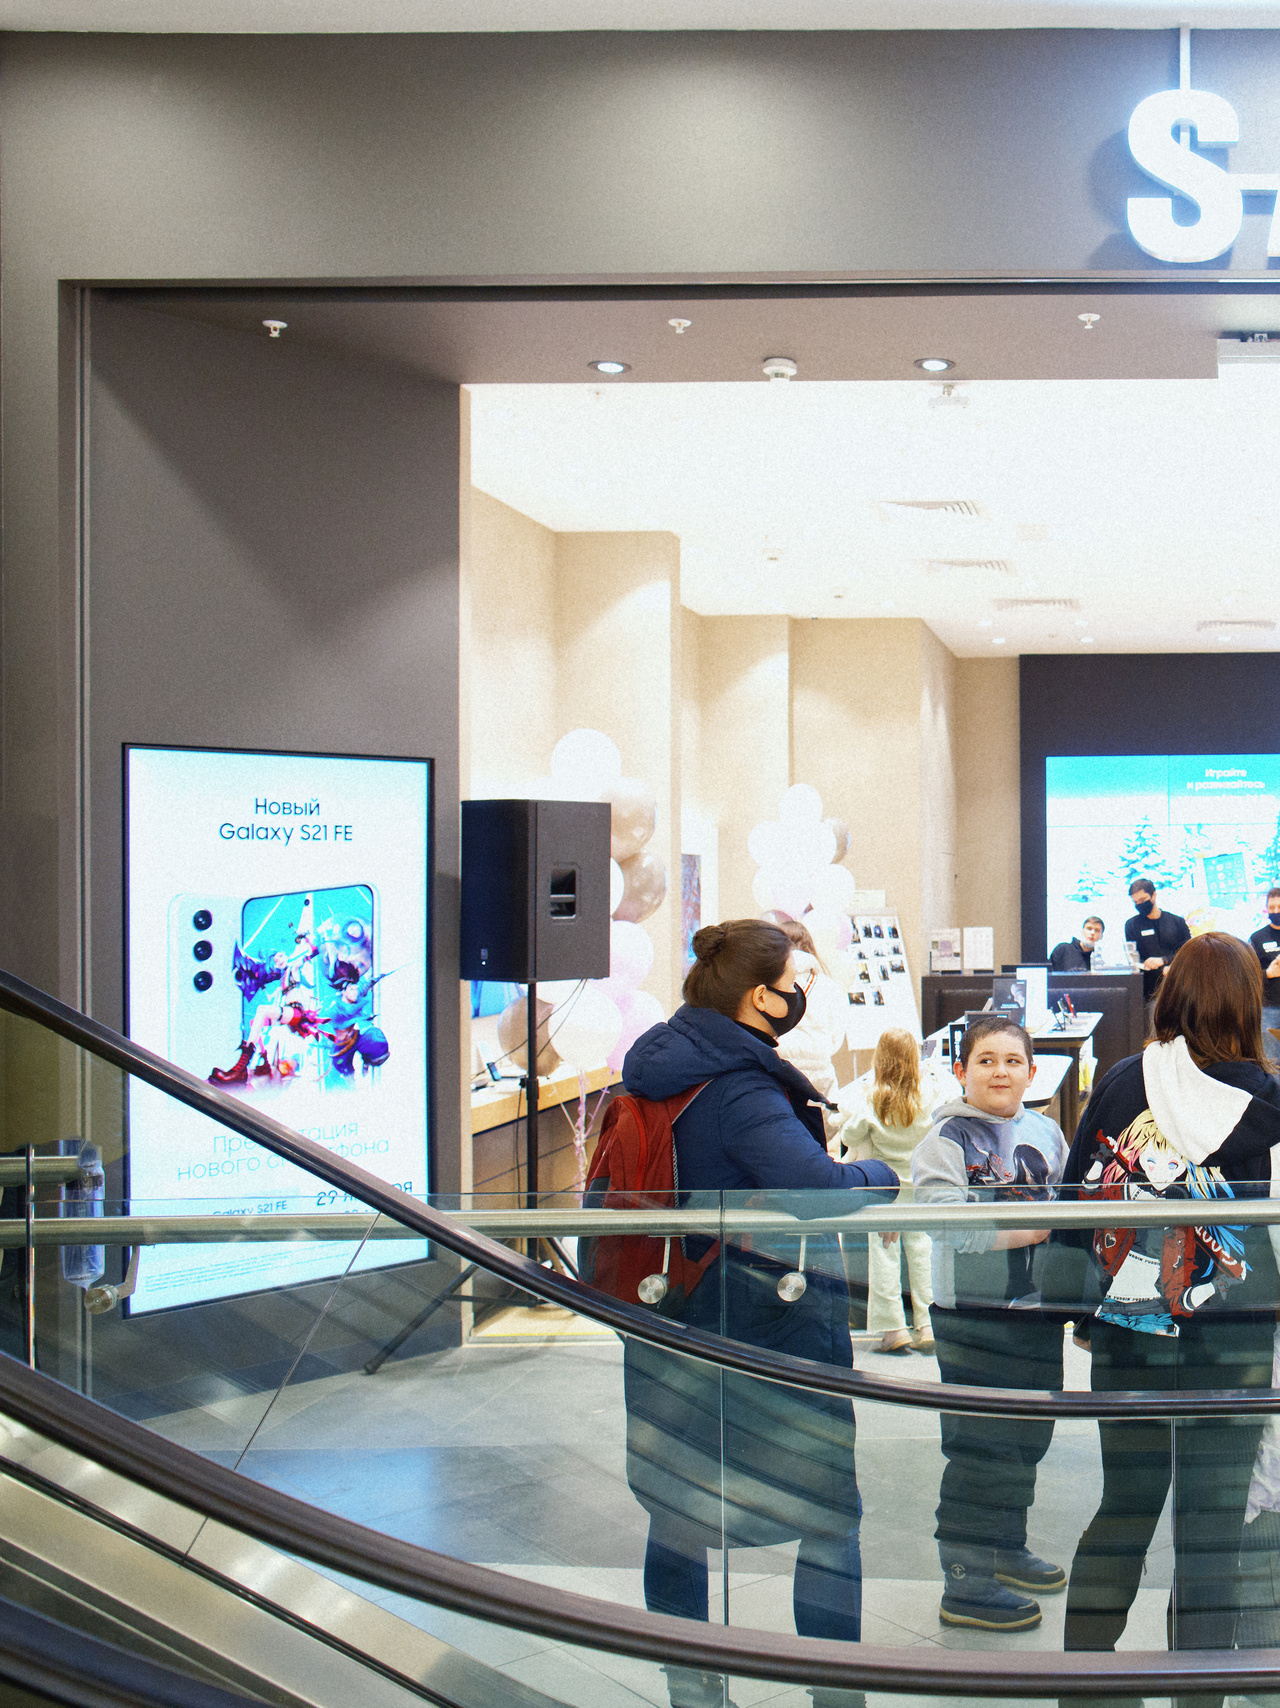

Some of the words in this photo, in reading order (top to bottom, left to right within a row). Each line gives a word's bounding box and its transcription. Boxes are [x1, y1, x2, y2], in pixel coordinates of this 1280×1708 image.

[1205, 767, 1248, 779] Играйте
[1186, 781, 1194, 789] и
[254, 797, 320, 816] Новый
[219, 822, 294, 847] Galaxy
[300, 824, 328, 841] S21
[334, 825, 353, 841] FE
[213, 1121, 359, 1158] Претация
[177, 1156, 261, 1182] нового
[266, 1139, 390, 1169] сфона
[256, 1202, 274, 1214] S21
[275, 1200, 288, 1211] FE
[316, 1189, 339, 1207] 29
